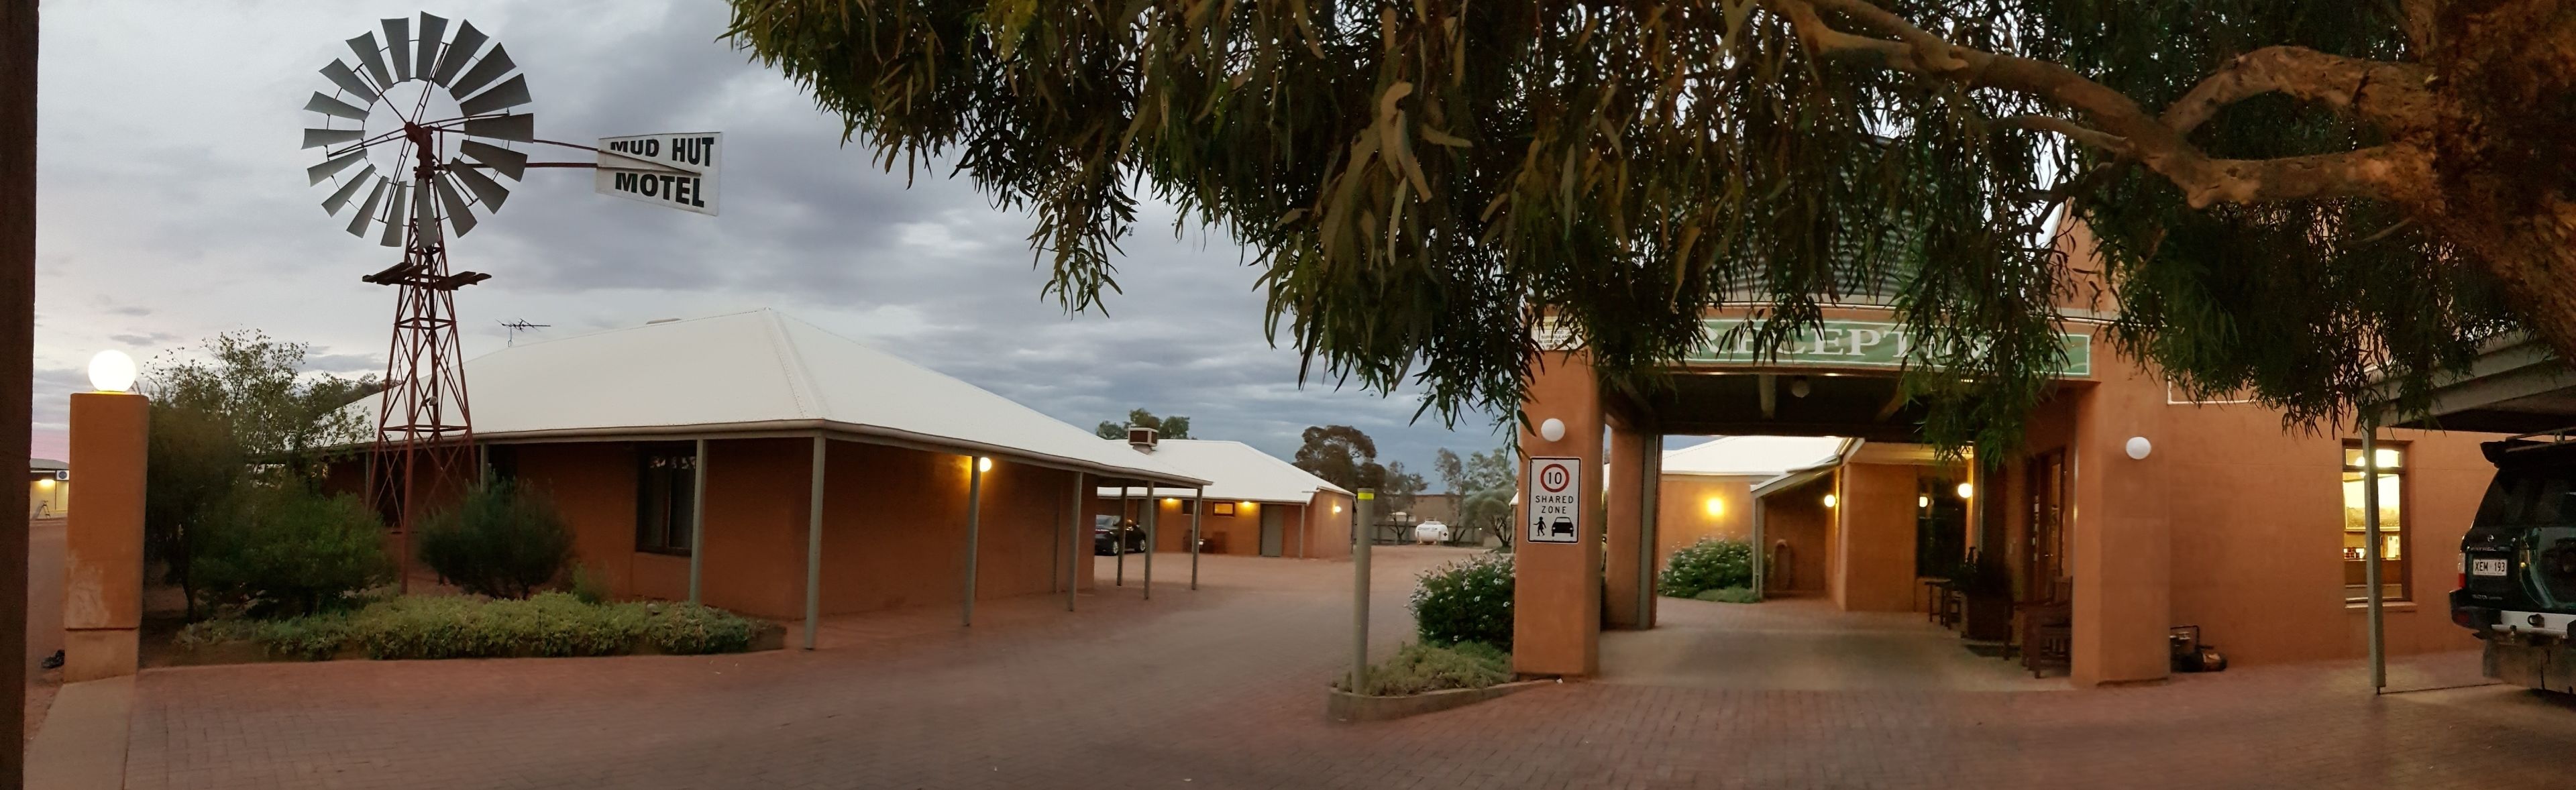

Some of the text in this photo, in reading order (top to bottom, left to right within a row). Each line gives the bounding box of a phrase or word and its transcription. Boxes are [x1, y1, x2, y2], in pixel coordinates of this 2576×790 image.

[610, 137, 714, 166] MUD HUT
[615, 172, 704, 208] MOTEL
[1548, 471, 1562, 485] 10
[1535, 495, 1574, 504] SHARED
[1541, 506, 1566, 514] ZONE
[2475, 561, 2506, 572] XEM 193
